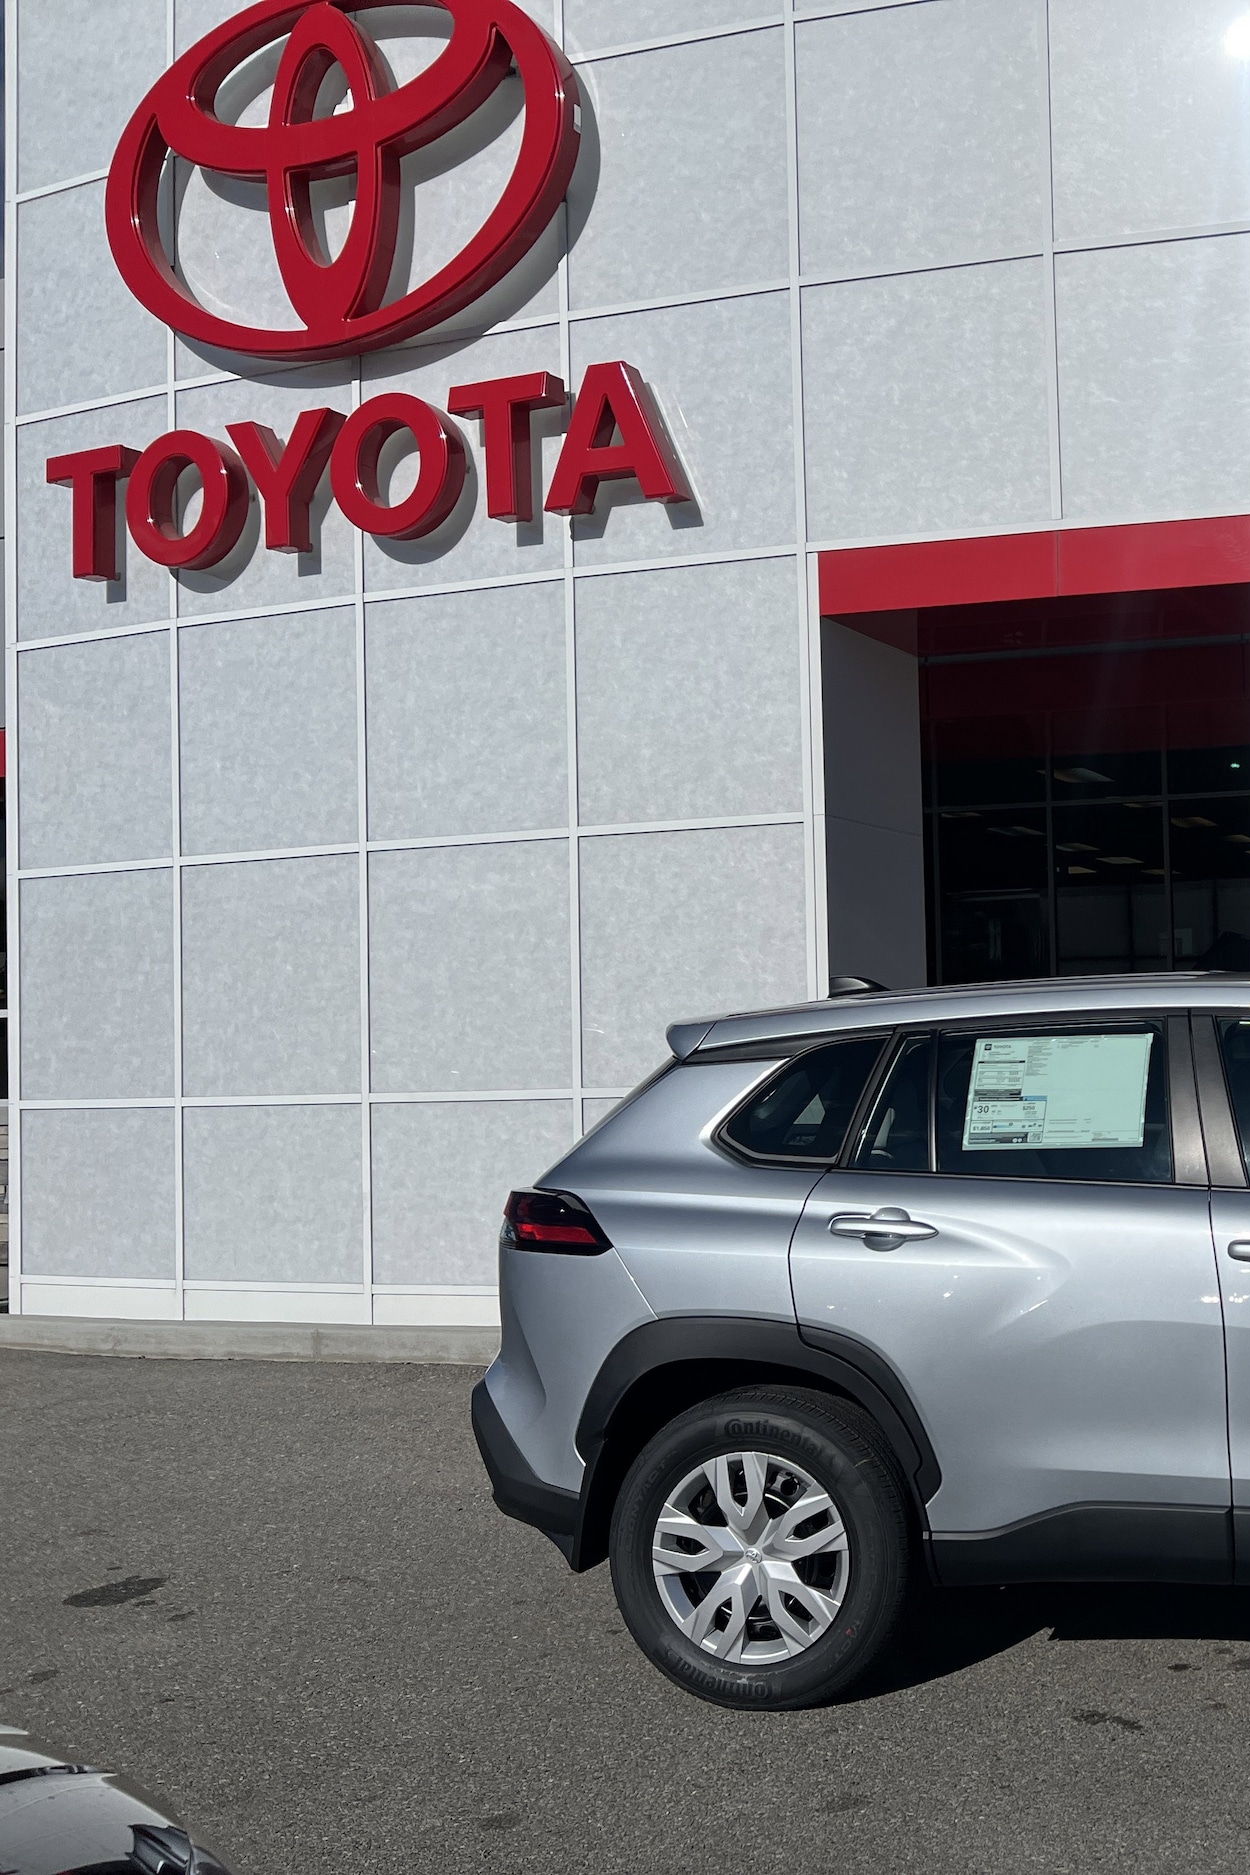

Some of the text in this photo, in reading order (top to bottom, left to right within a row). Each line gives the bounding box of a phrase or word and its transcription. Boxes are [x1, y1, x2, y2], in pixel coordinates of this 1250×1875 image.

[46, 359, 694, 583] TOYOTA
[977, 1105, 990, 1114] 30
[724, 1418, 824, 1457] Continental
